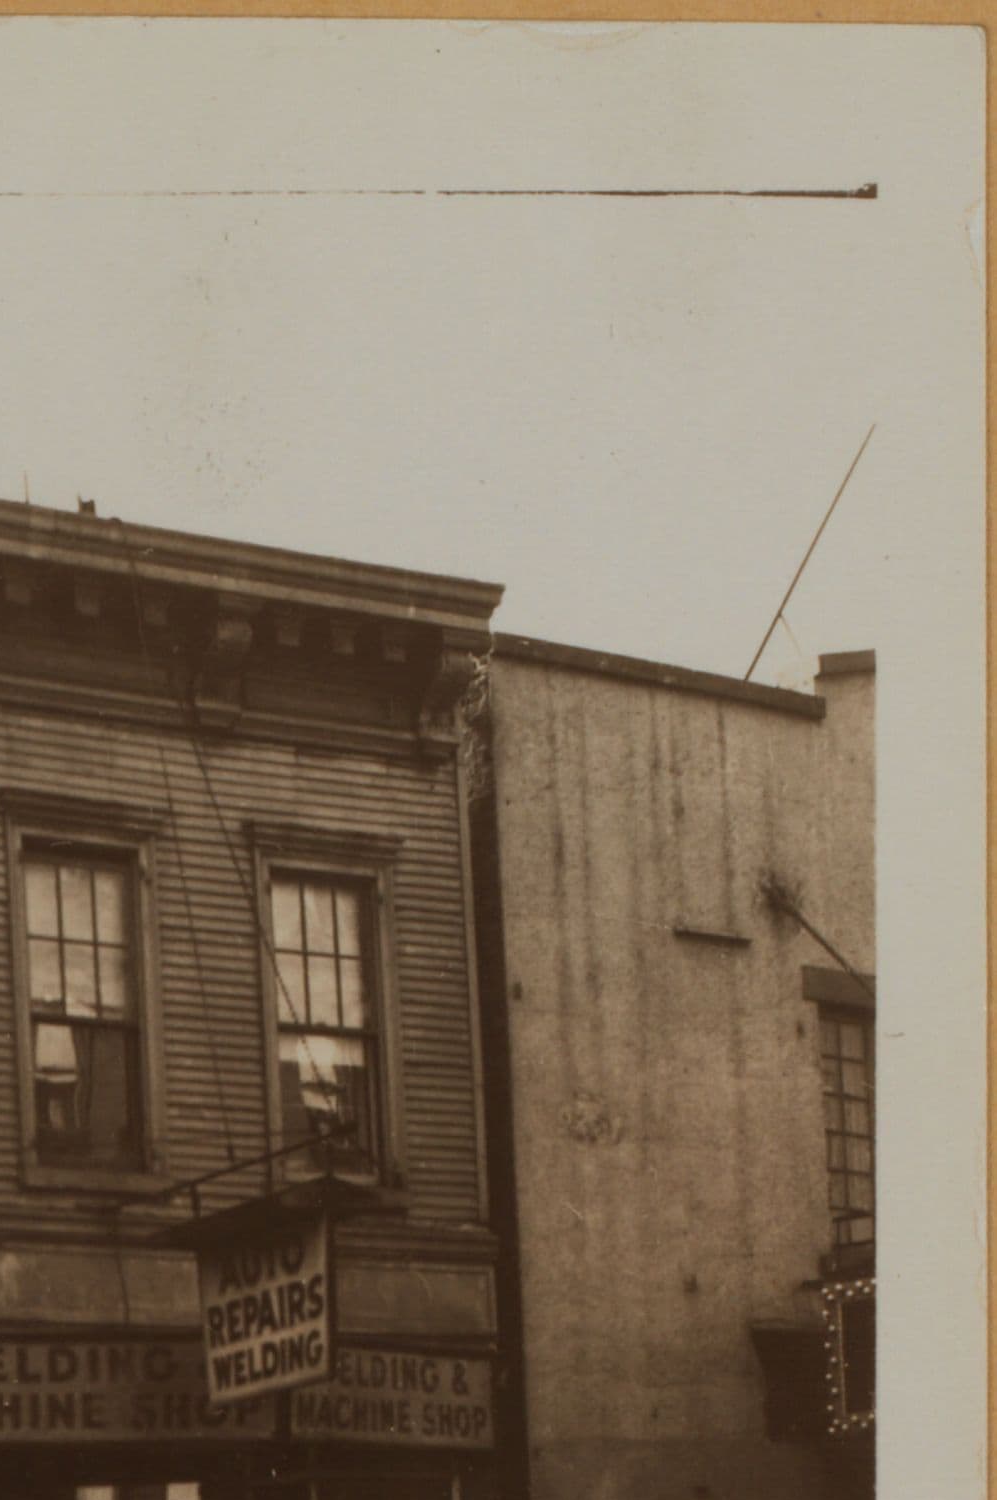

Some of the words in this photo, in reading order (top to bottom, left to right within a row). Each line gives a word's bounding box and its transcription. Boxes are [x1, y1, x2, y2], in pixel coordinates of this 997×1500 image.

[218, 1240, 305, 1294] AUTO
[206, 1274, 325, 1348] REPAIRS
[212, 1330, 324, 1391] WELDING
[334, 1350, 440, 1395] ELDING
[451, 1362, 470, 1396] &
[296, 1391, 413, 1434] MACHINE
[420, 1401, 488, 1440] SHOP
